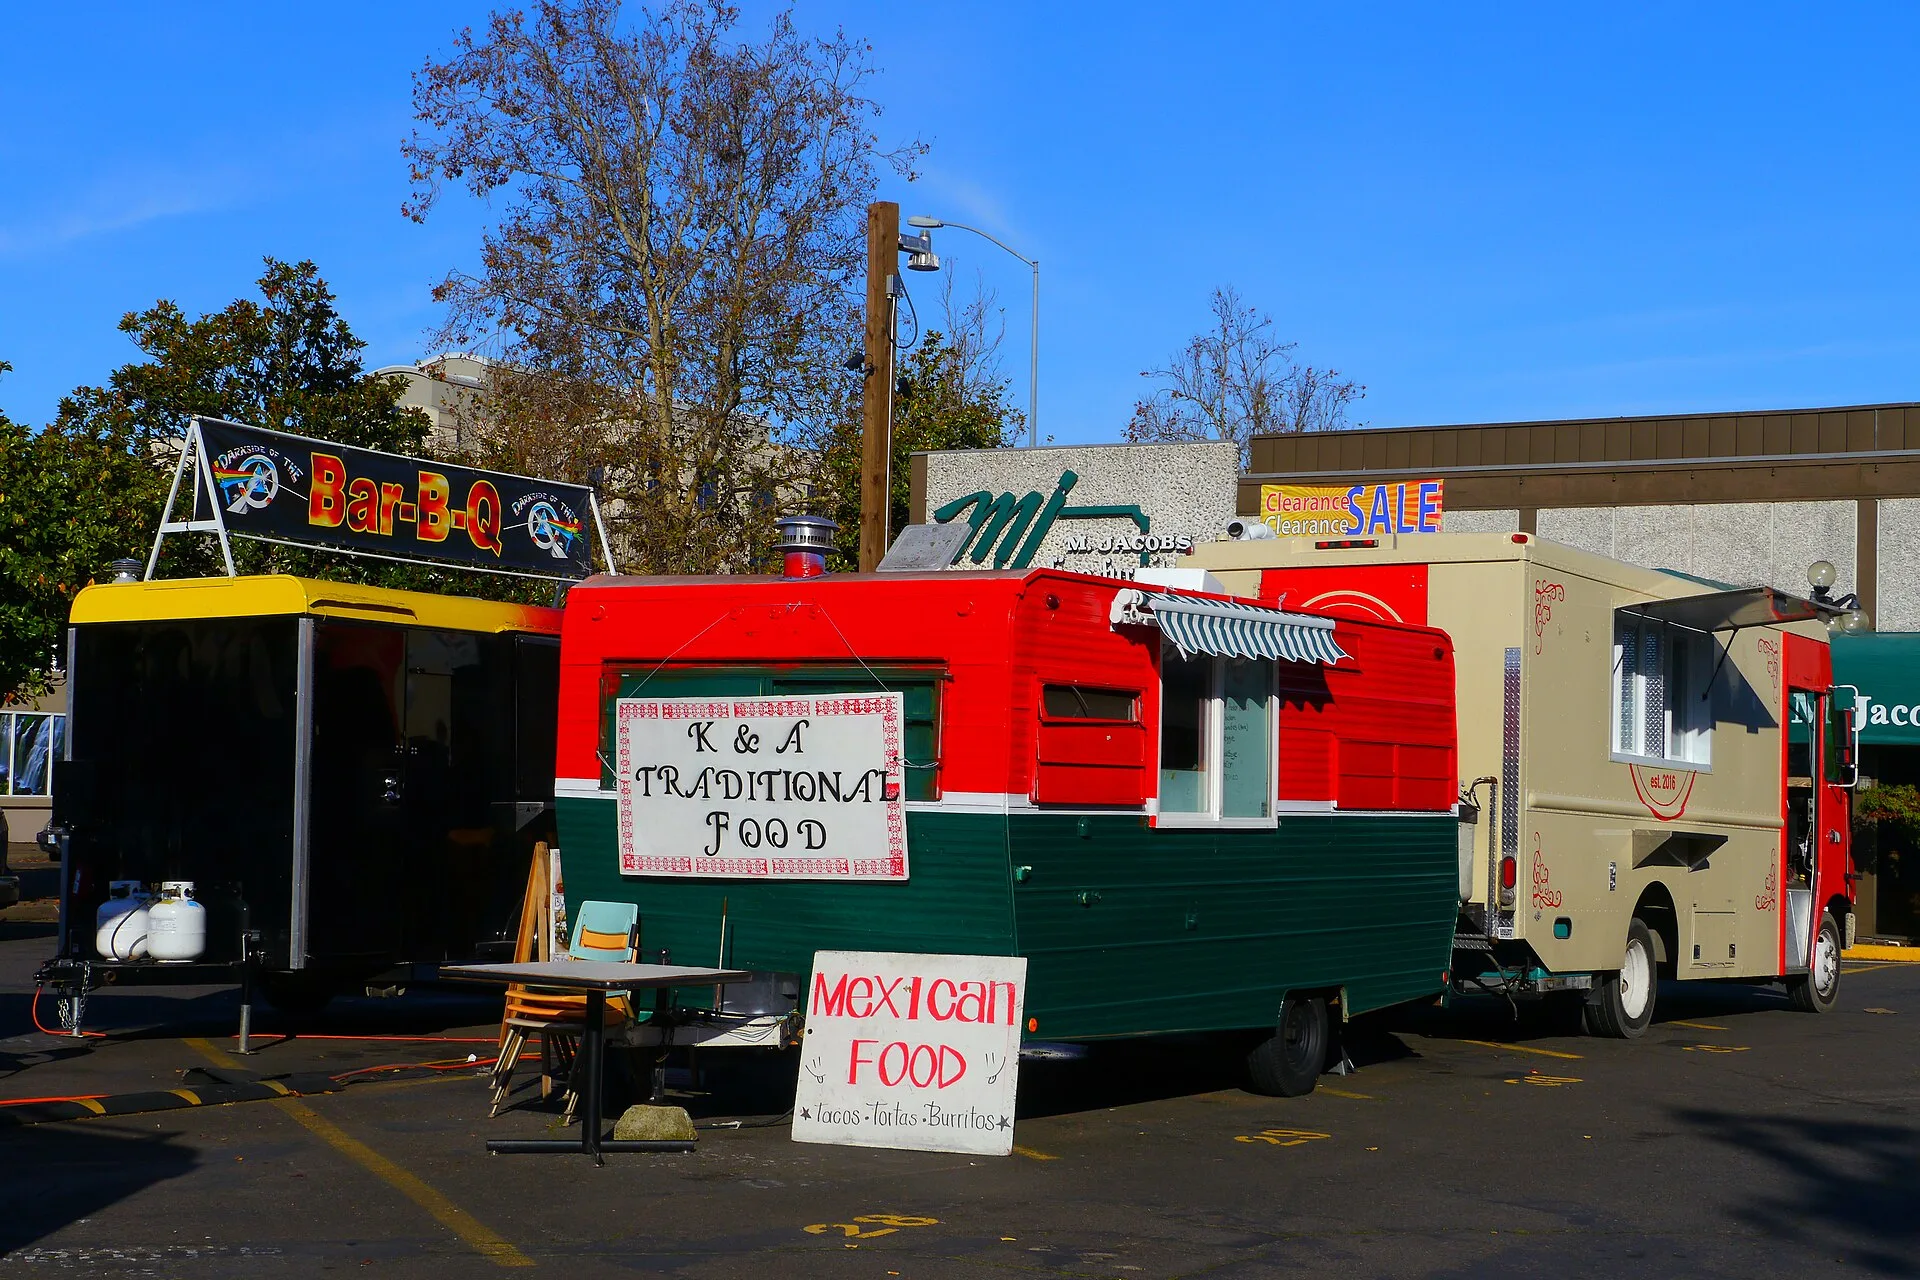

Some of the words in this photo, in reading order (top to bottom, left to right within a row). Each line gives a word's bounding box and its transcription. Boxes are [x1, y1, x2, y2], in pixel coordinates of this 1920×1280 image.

[269, 448, 280, 458] OF
[283, 456, 304, 483] THE
[308, 451, 502, 558] Bar-B-Q
[1265, 491, 1350, 513] Clearance
[1345, 482, 1440, 536] SALE
[1263, 514, 1350, 536] Clearance
[1064, 535, 1091, 553] M.
[1099, 534, 1193, 554] JACOBS
[687, 721, 718, 753] K
[733, 723, 759, 754] &
[775, 719, 809, 754] A
[635, 764, 899, 803] TRADITIONAL
[1662, 773, 1676, 790] 2016
[704, 811, 827, 857] FOOD
[847, 1039, 967, 1089] FOOD
[814, 1103, 860, 1125] Tacos
[866, 1101, 918, 1127] Tortas
[923, 1101, 995, 1131] Burritos
